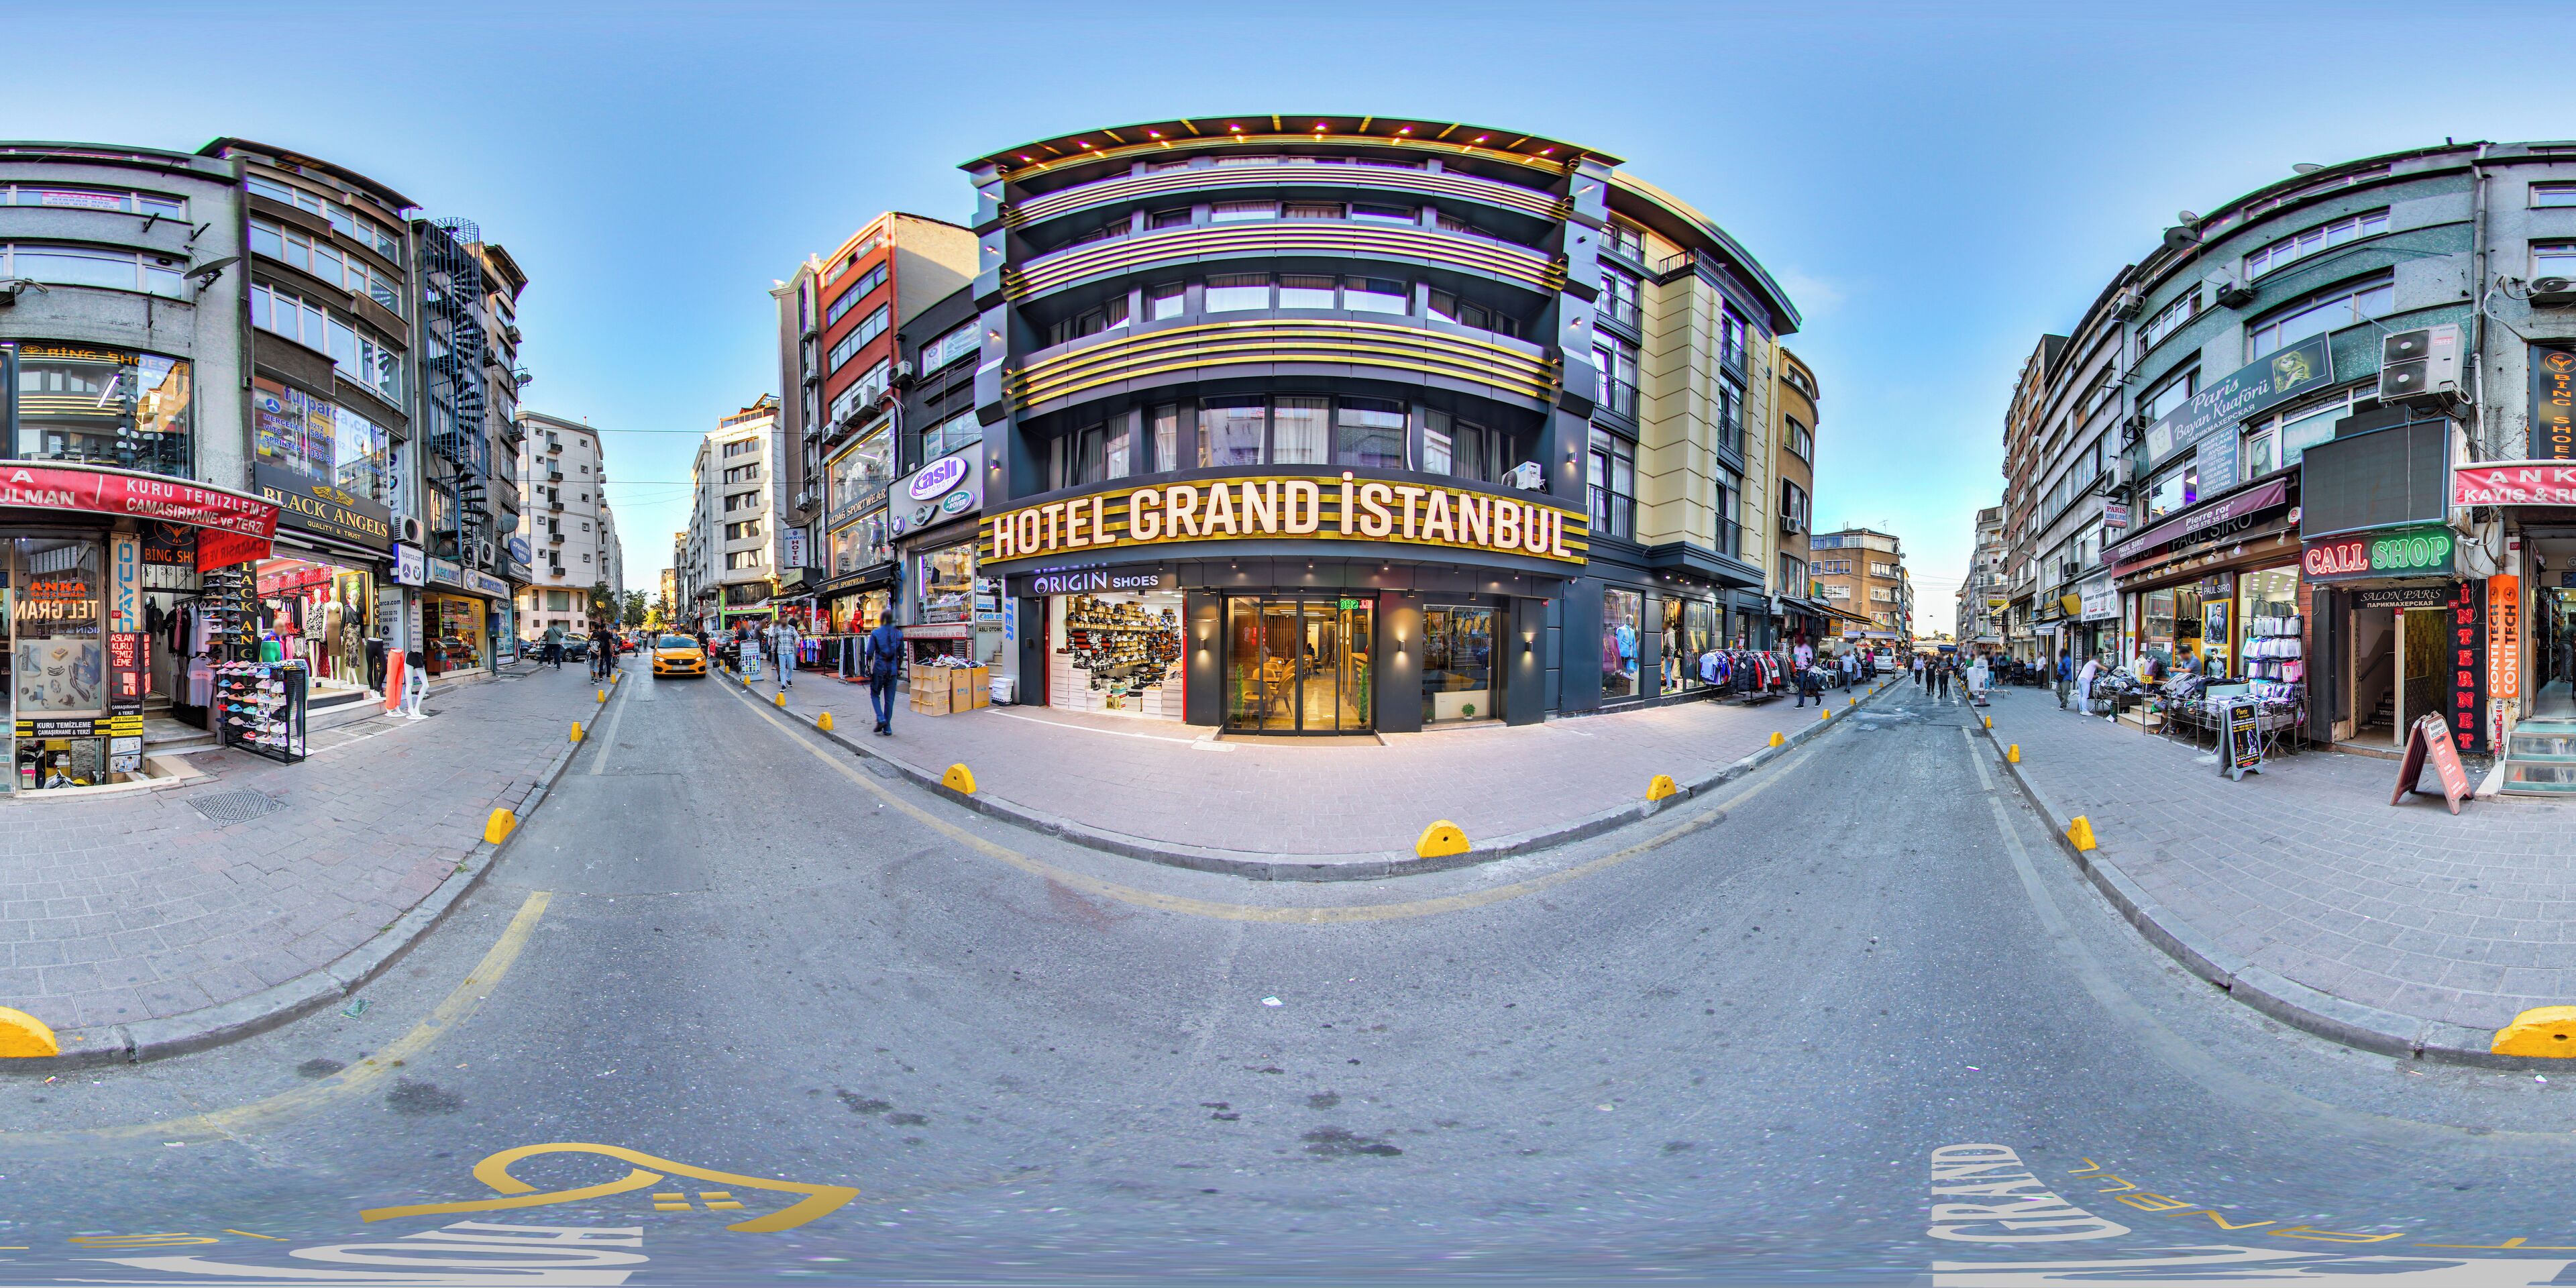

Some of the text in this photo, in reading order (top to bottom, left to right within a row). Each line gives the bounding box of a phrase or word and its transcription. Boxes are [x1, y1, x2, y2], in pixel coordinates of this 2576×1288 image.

[2191, 378, 2239, 414] Paris
[2174, 379, 2270, 441] Bayan Kuaförü
[2290, 399, 2340, 419] ЦВЕТНЫЕ ЛИНЗЫ
[263, 413, 305, 433] MERCEDES
[263, 423, 283, 436] VITO
[2186, 403, 2255, 444] ПАРИКМАХЕРСКАЯ
[264, 435, 303, 453] SPRINTER
[310, 429, 325, 441] 586
[326, 436, 335, 445] 86
[2201, 428, 2235, 448] MARY KAY
[310, 449, 325, 461] 033
[2208, 443, 2226, 456] AVON
[2208, 456, 2226, 468] TATTOO
[2218, 472, 2231, 482] LENS
[126, 479, 173, 498] KURU
[2464, 487, 2548, 503] KAYIŞ &
[947, 494, 961, 504] LAND
[948, 498, 967, 510] ROVER
[262, 486, 388, 538] BLACK ANGELS
[827, 488, 887, 527] AKDAĞ SPORTWEAR
[994, 471, 1572, 559] HOTEL GRAND İSTANBUL
[219, 517, 234, 527] ve
[2186, 512, 2213, 527] Pierre
[2186, 512, 2229, 533] 0536 576 35 95
[307, 520, 333, 532] QUALITY
[343, 531, 362, 540] TRUST
[144, 546, 172, 563] BİNG
[519, 551, 527, 561] VITO
[791, 539, 800, 566] HOTEL
[2118, 543, 2131, 555] PAUL
[2305, 535, 2450, 576] CALL SHOP
[30, 582, 87, 592] ANKA
[117, 542, 134, 633] DAYCO
[239, 562, 254, 612] LACK
[840, 576, 866, 589] SPORTWEAR
[1112, 574, 1159, 588] SHOES
[2204, 583, 2231, 596] PAUL SIRO
[2360, 591, 2404, 602] SALON
[496, 600, 510, 608] FORD
[2367, 600, 2434, 608] ПАРИКМАХЕРСКАЯ
[110, 633, 135, 643] ASLAN
[111, 642, 132, 651] KURU
[2489, 604, 2499, 694] CONTITECH
[2504, 604, 2516, 694] CONTITECH
[113, 658, 132, 667] LEME
[2457, 583, 2475, 749] İNTERNET
[56, 720, 92, 729] TEMİZLEME
